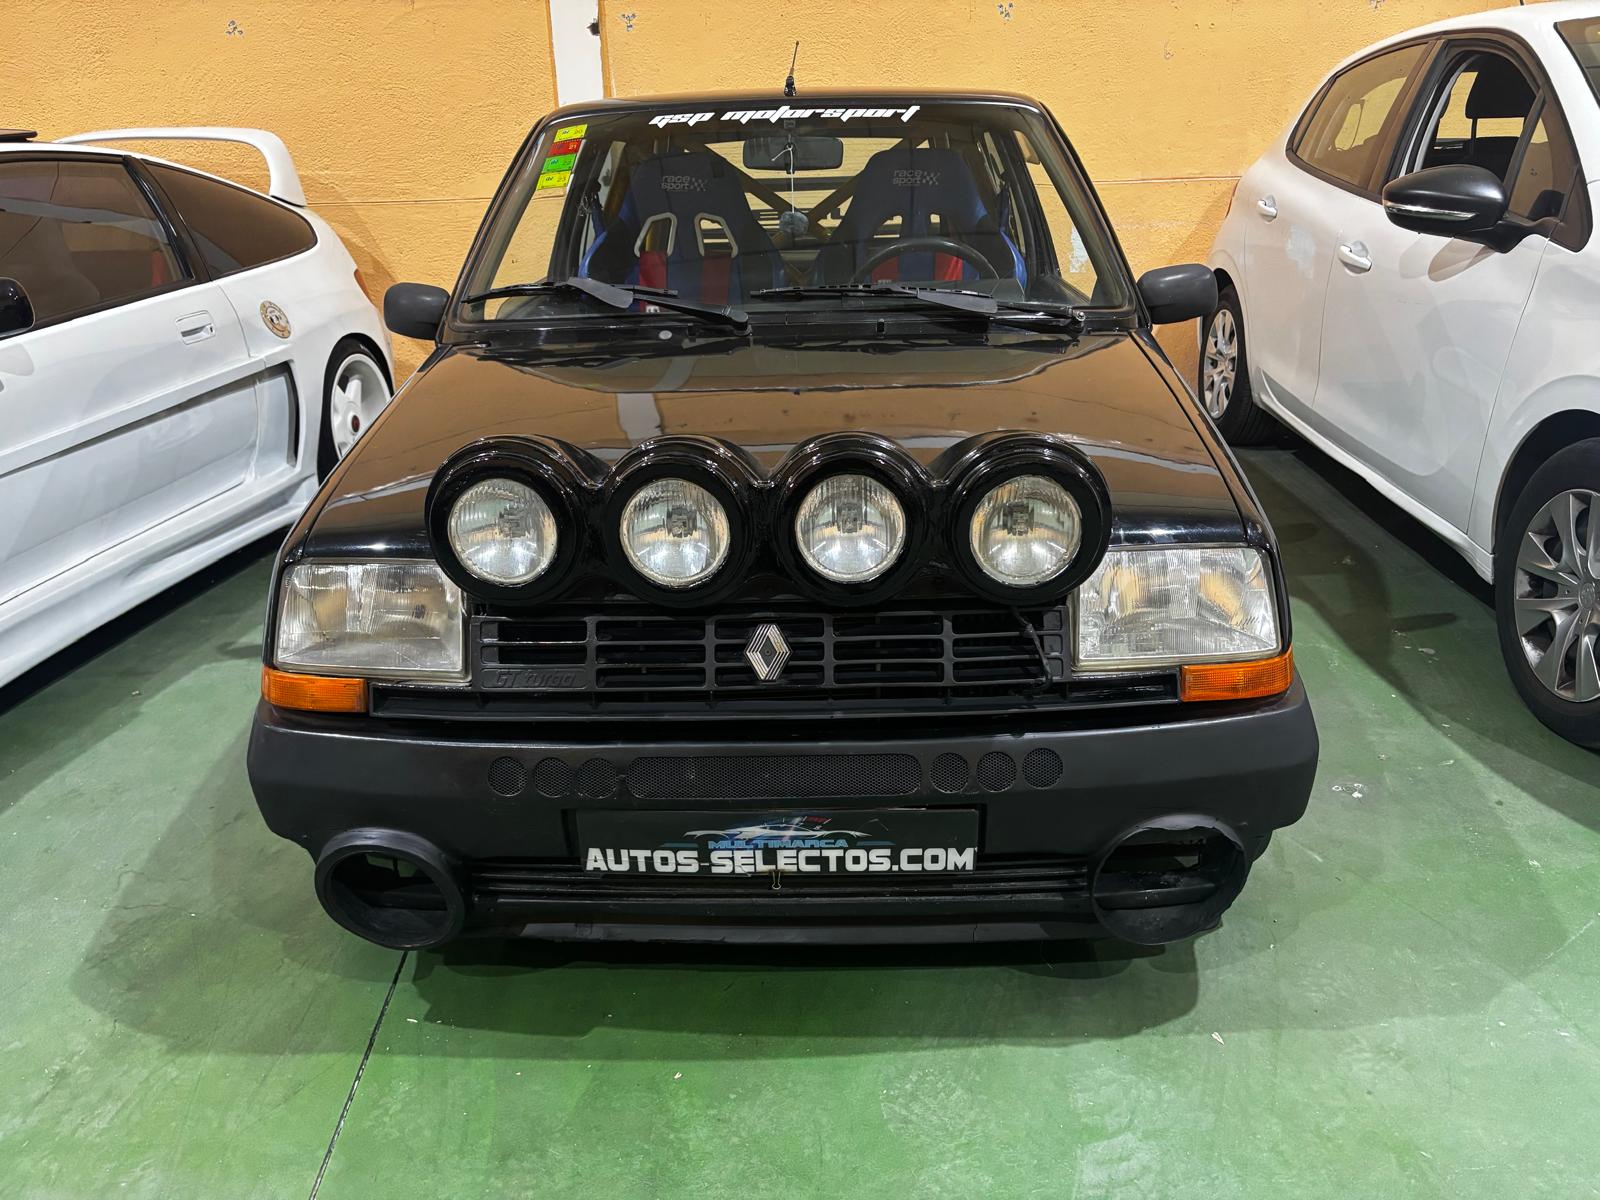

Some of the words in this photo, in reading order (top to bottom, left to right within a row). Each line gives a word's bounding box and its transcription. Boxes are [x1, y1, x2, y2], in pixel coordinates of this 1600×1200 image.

[720, 105, 920, 123] motorsport
[662, 175, 690, 183] race
[707, 839, 849, 849] MULTIMARCA
[586, 847, 974, 873] AUTOS-SELECTOS.COM
